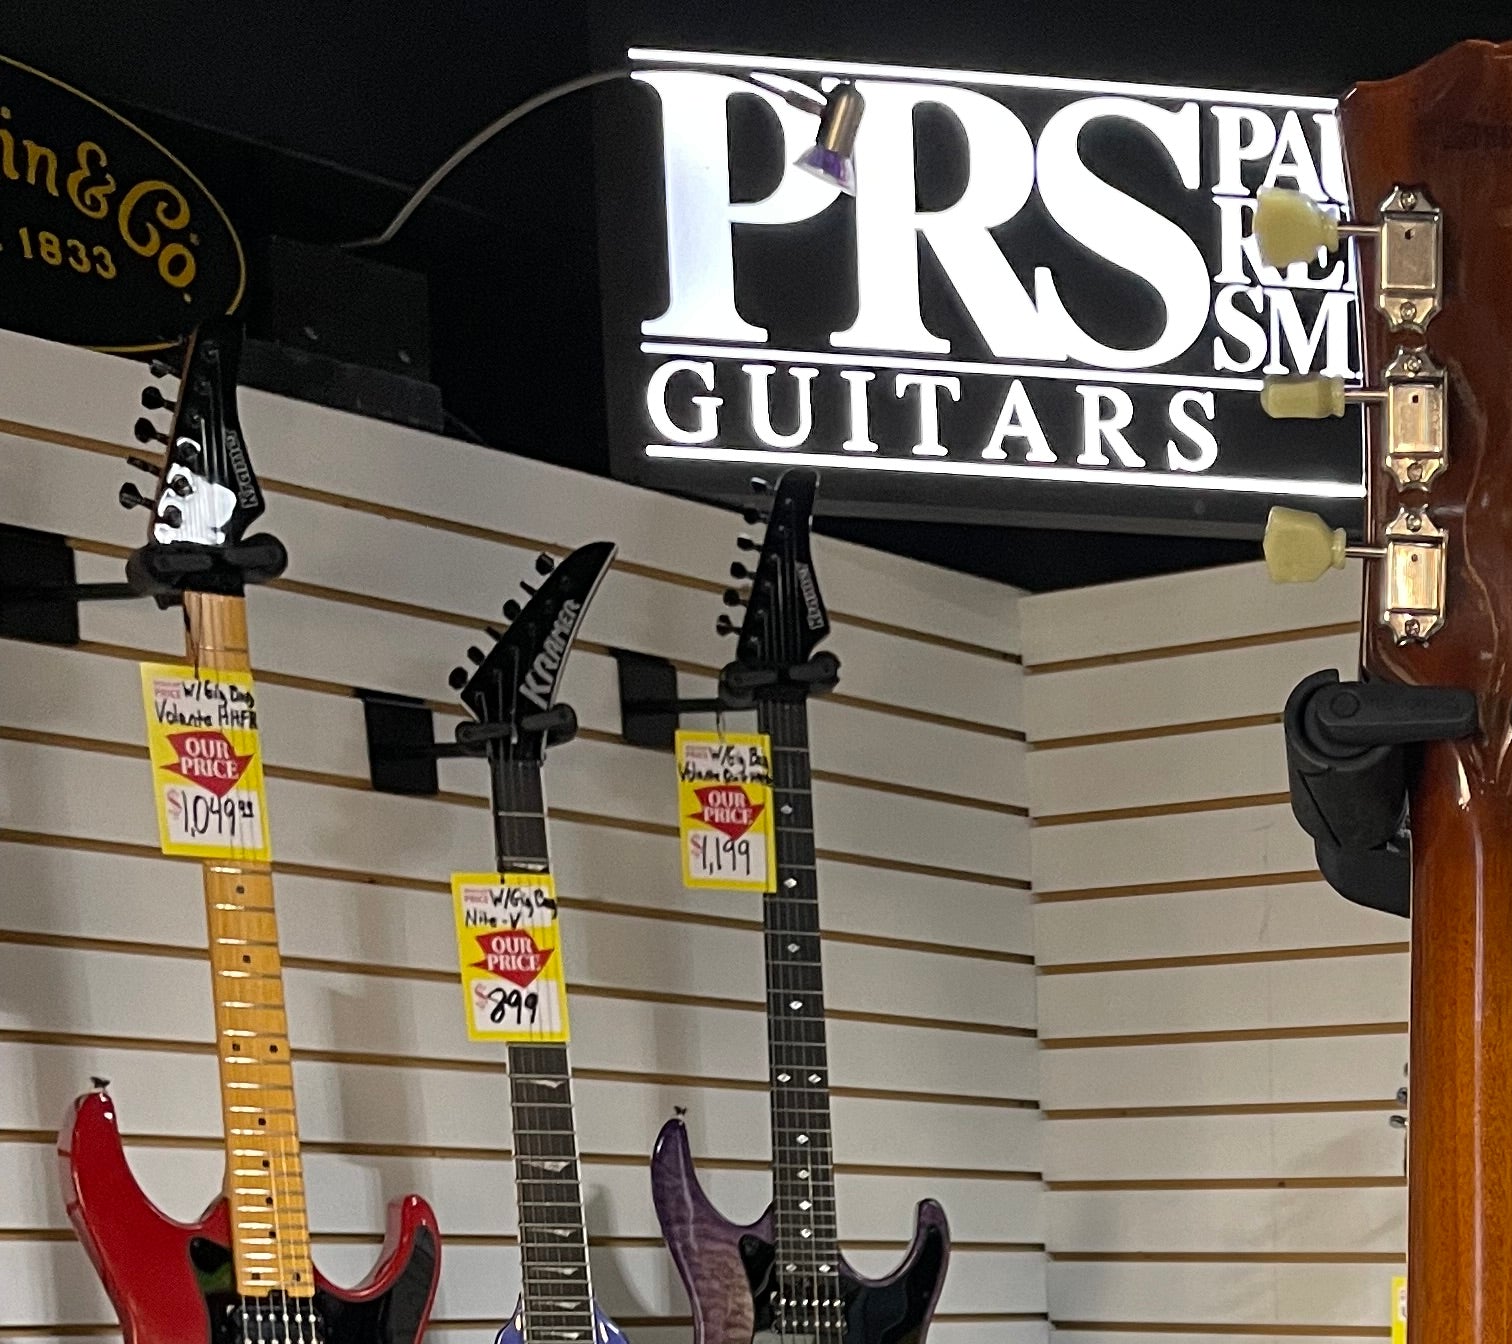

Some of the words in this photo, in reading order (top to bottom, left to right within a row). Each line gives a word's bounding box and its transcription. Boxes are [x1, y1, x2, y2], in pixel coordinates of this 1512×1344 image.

[630, 68, 1212, 370] PRS
[19, 227, 117, 280] 1833
[645, 360, 1219, 474] GUITARS
[185, 736, 229, 760] OUR
[181, 759, 239, 780] PRICE
[707, 790, 746, 808] OUR
[704, 806, 753, 824] PRICE
[690, 834, 750, 876] $1,199
[491, 937, 532, 954] OUR
[487, 953, 541, 971] PRICE
[475, 983, 539, 1025] $899
